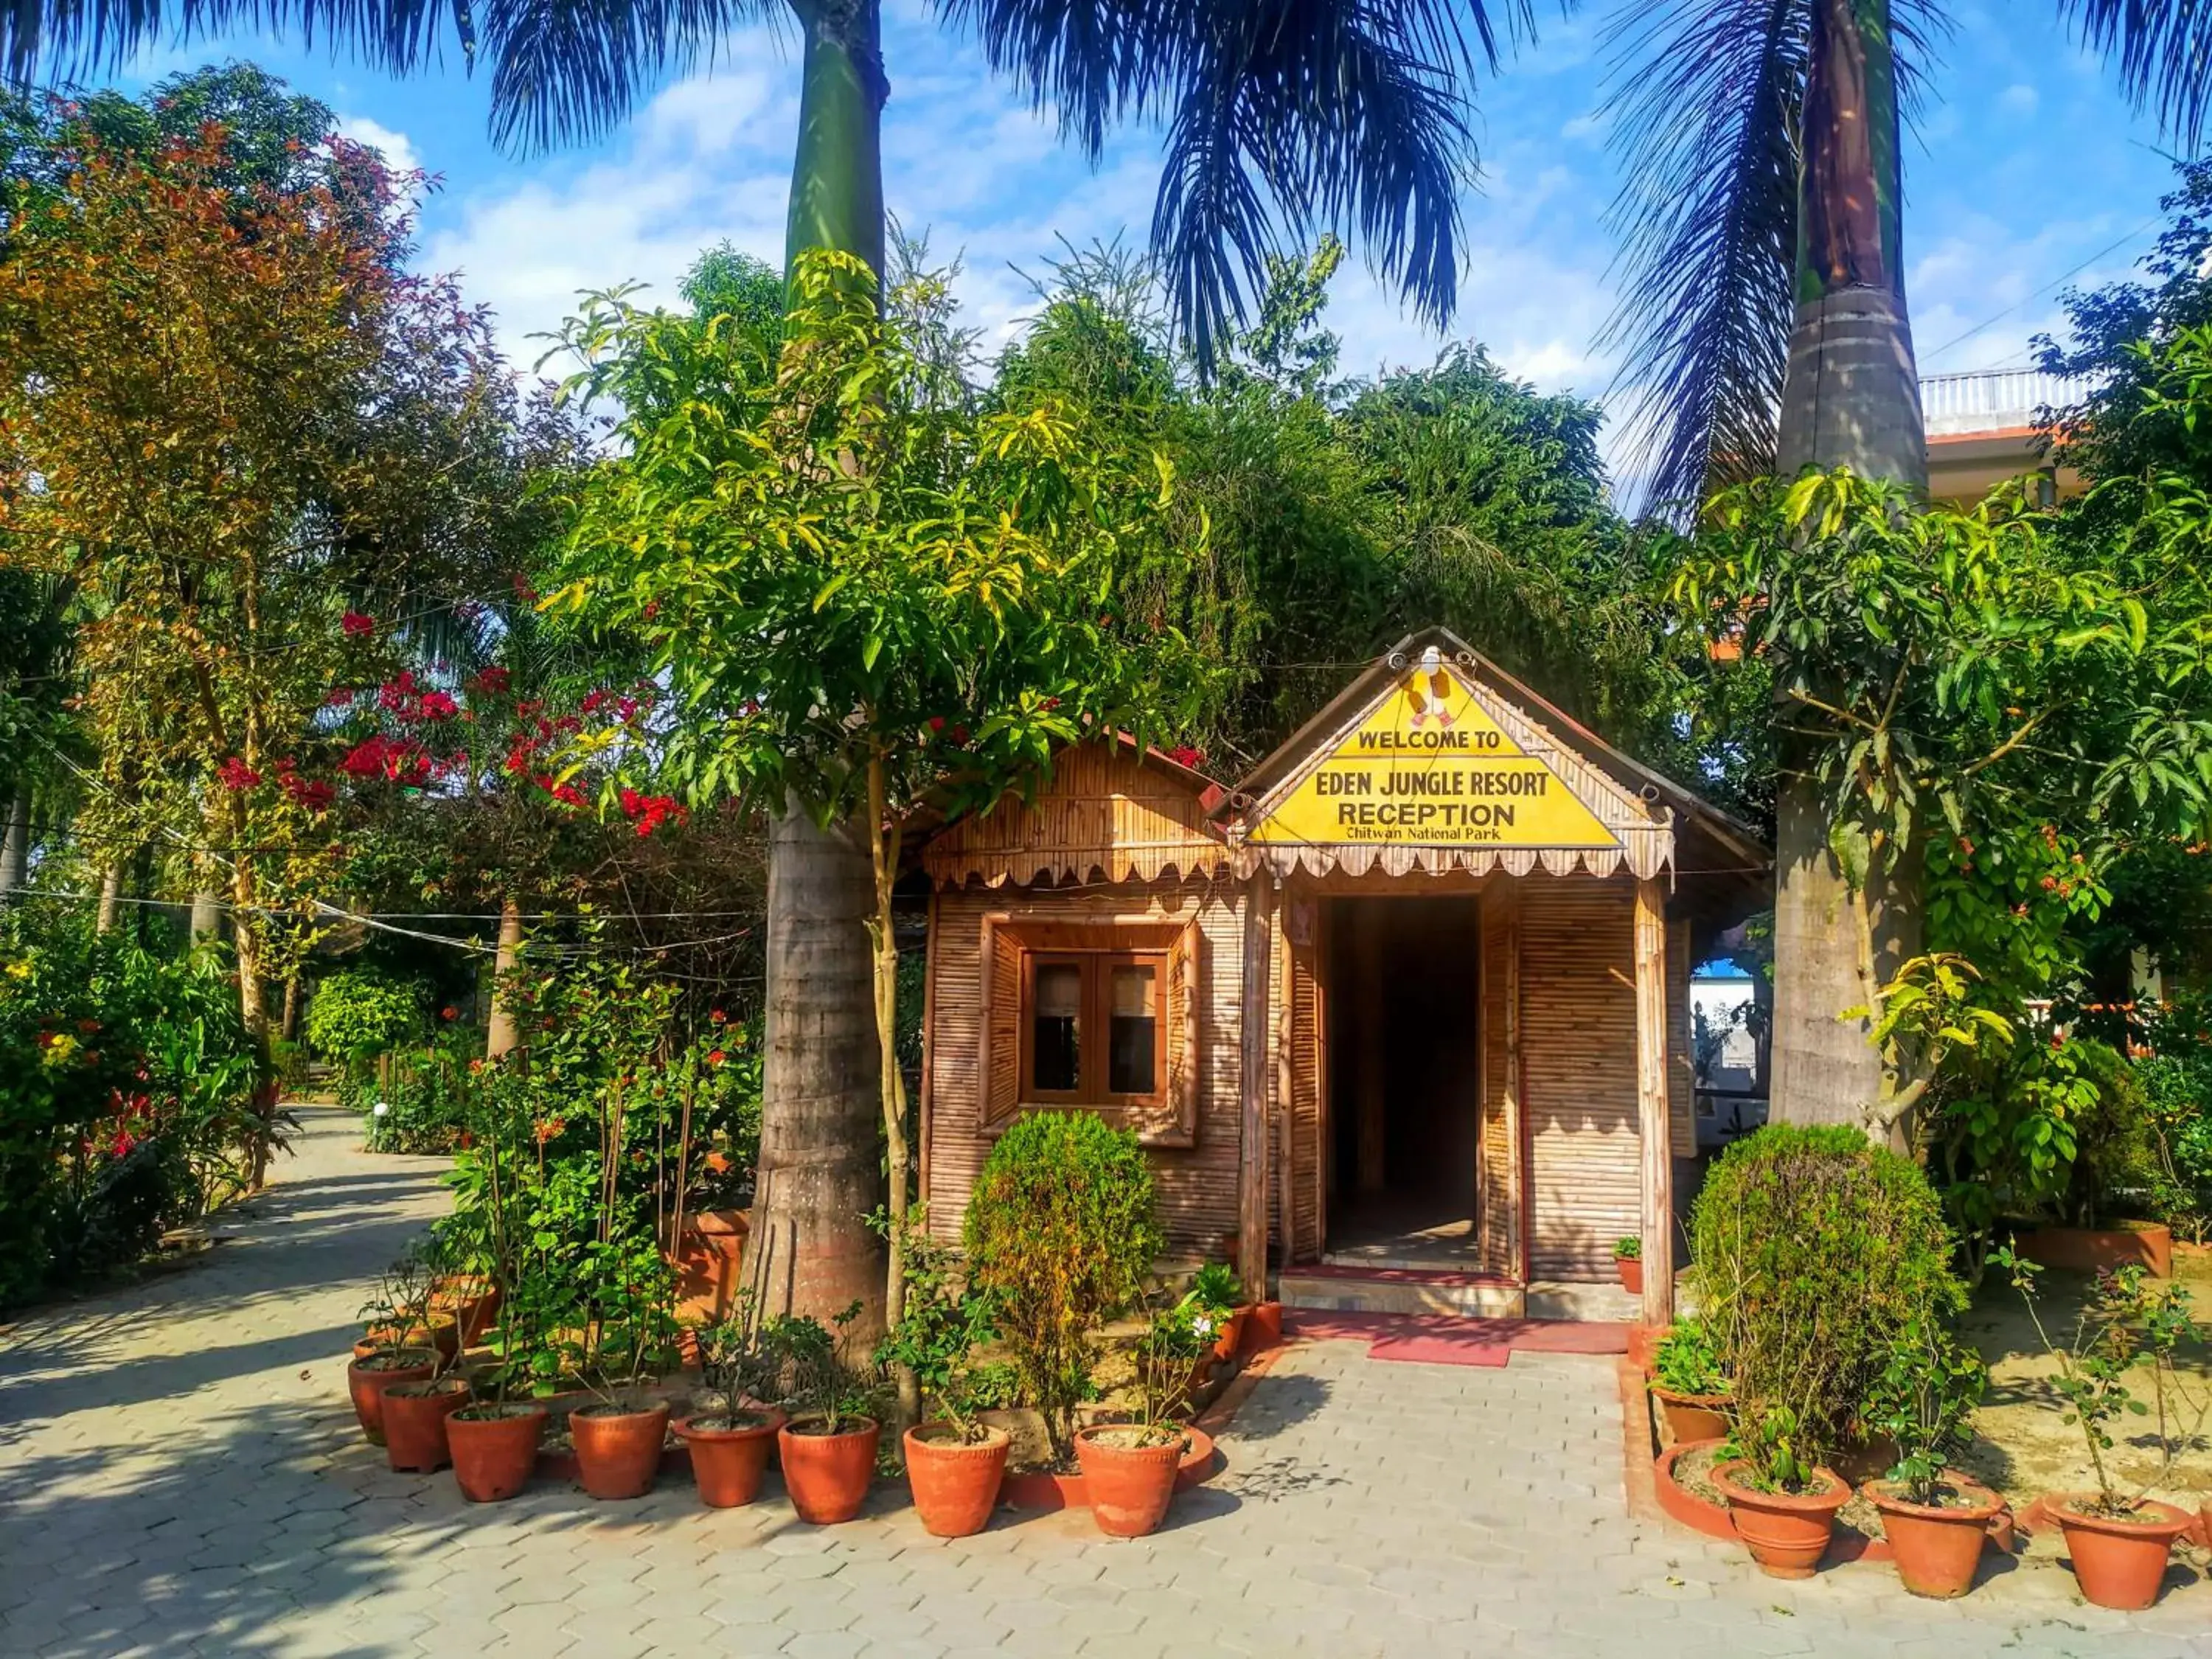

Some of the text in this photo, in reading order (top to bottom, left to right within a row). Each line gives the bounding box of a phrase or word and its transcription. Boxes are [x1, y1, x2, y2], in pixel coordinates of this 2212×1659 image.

[1358, 731, 1500, 748] WELCOME TO
[1316, 772, 1548, 796] EDEN JUNGLE RESORT
[1338, 803, 1515, 827] RECEPTION
[1346, 826, 1501, 840] Chitwan National Park
